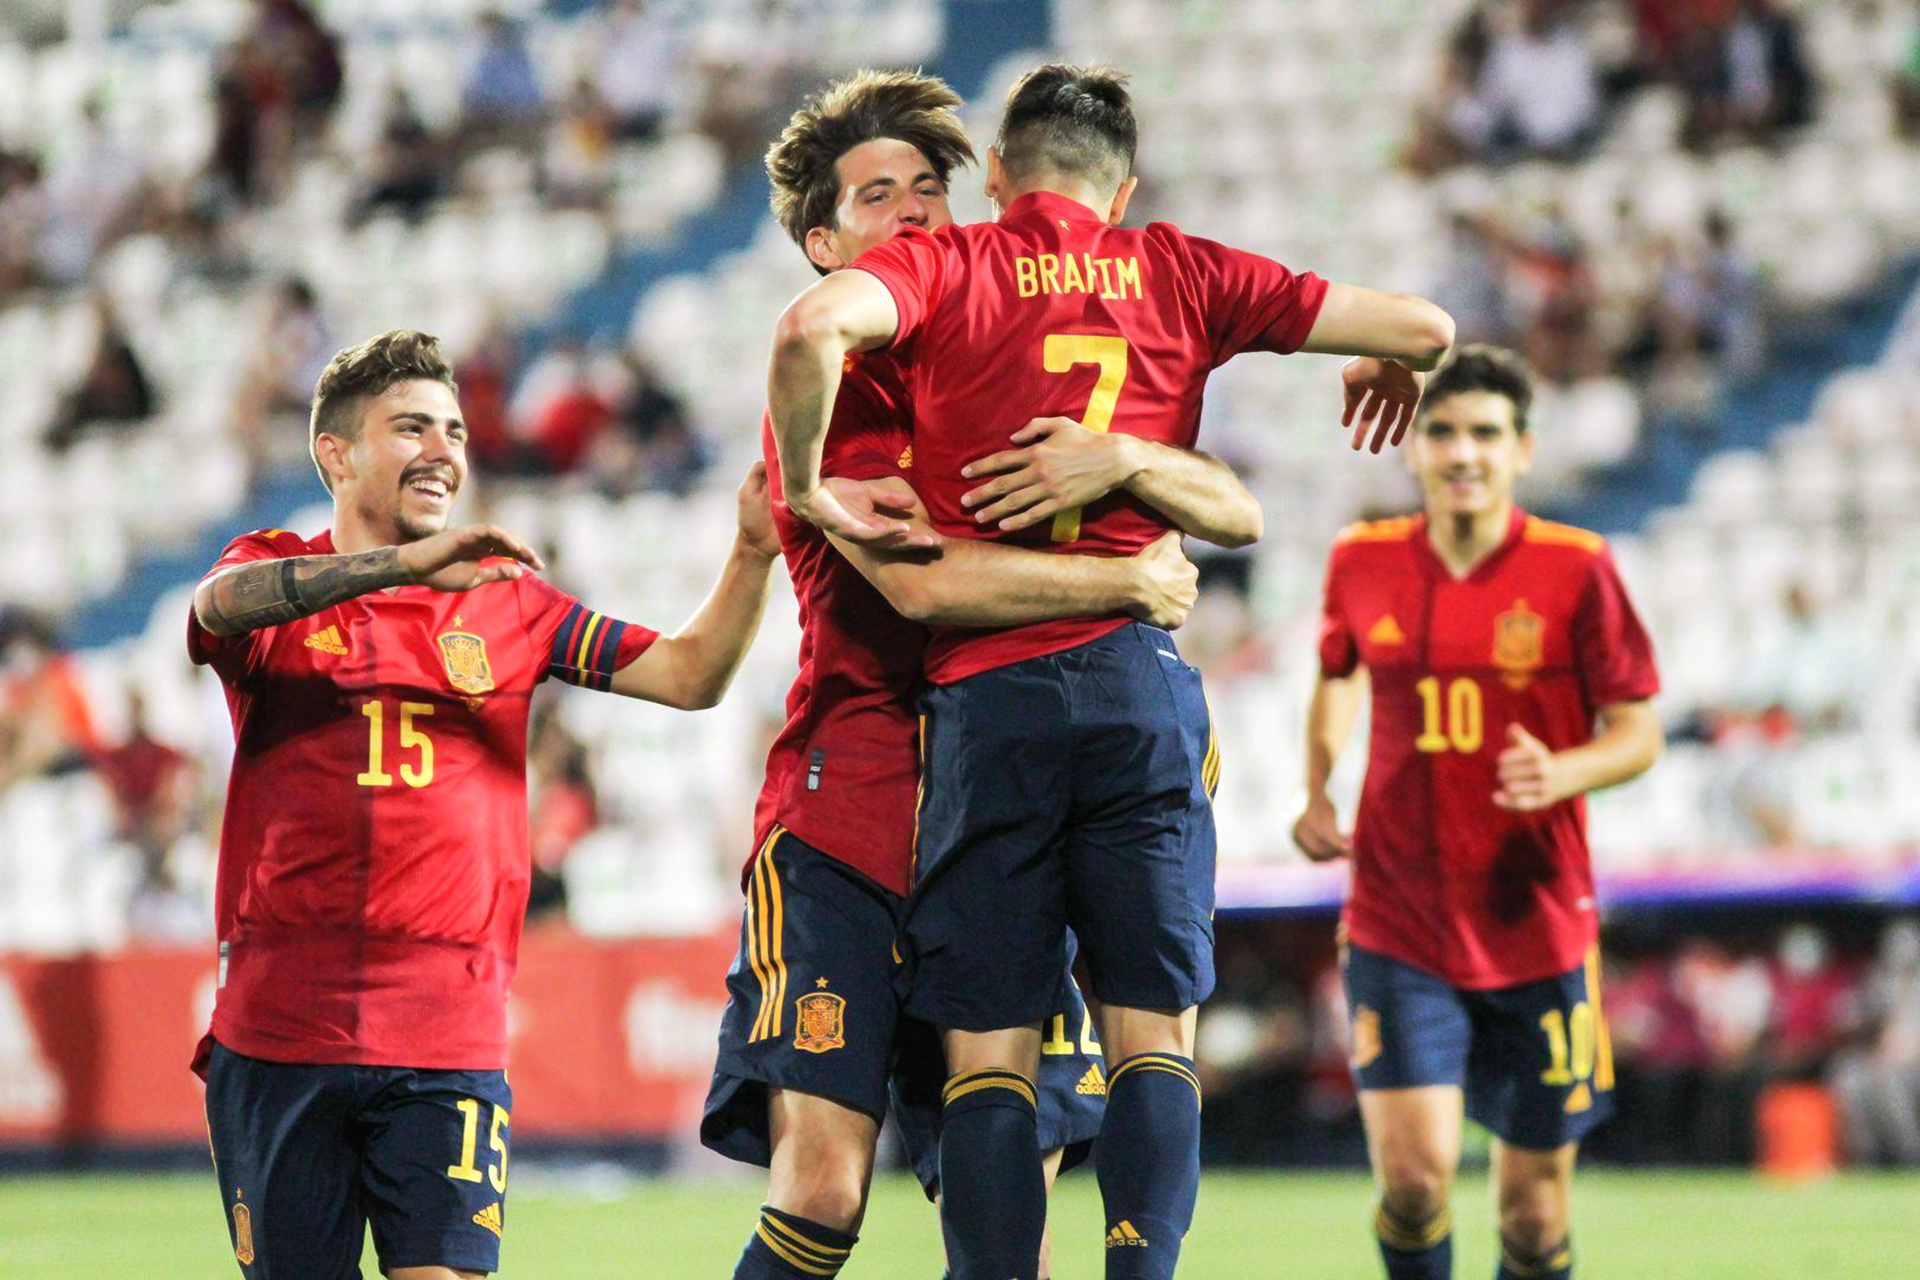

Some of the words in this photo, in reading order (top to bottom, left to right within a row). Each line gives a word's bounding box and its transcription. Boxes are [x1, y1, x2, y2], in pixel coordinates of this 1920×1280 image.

[1043, 334, 1128, 542] 7
[357, 700, 434, 788] 15
[1415, 676, 1483, 754] 10
[1540, 1002, 1594, 1085] 10
[447, 1098, 510, 1194] 15
